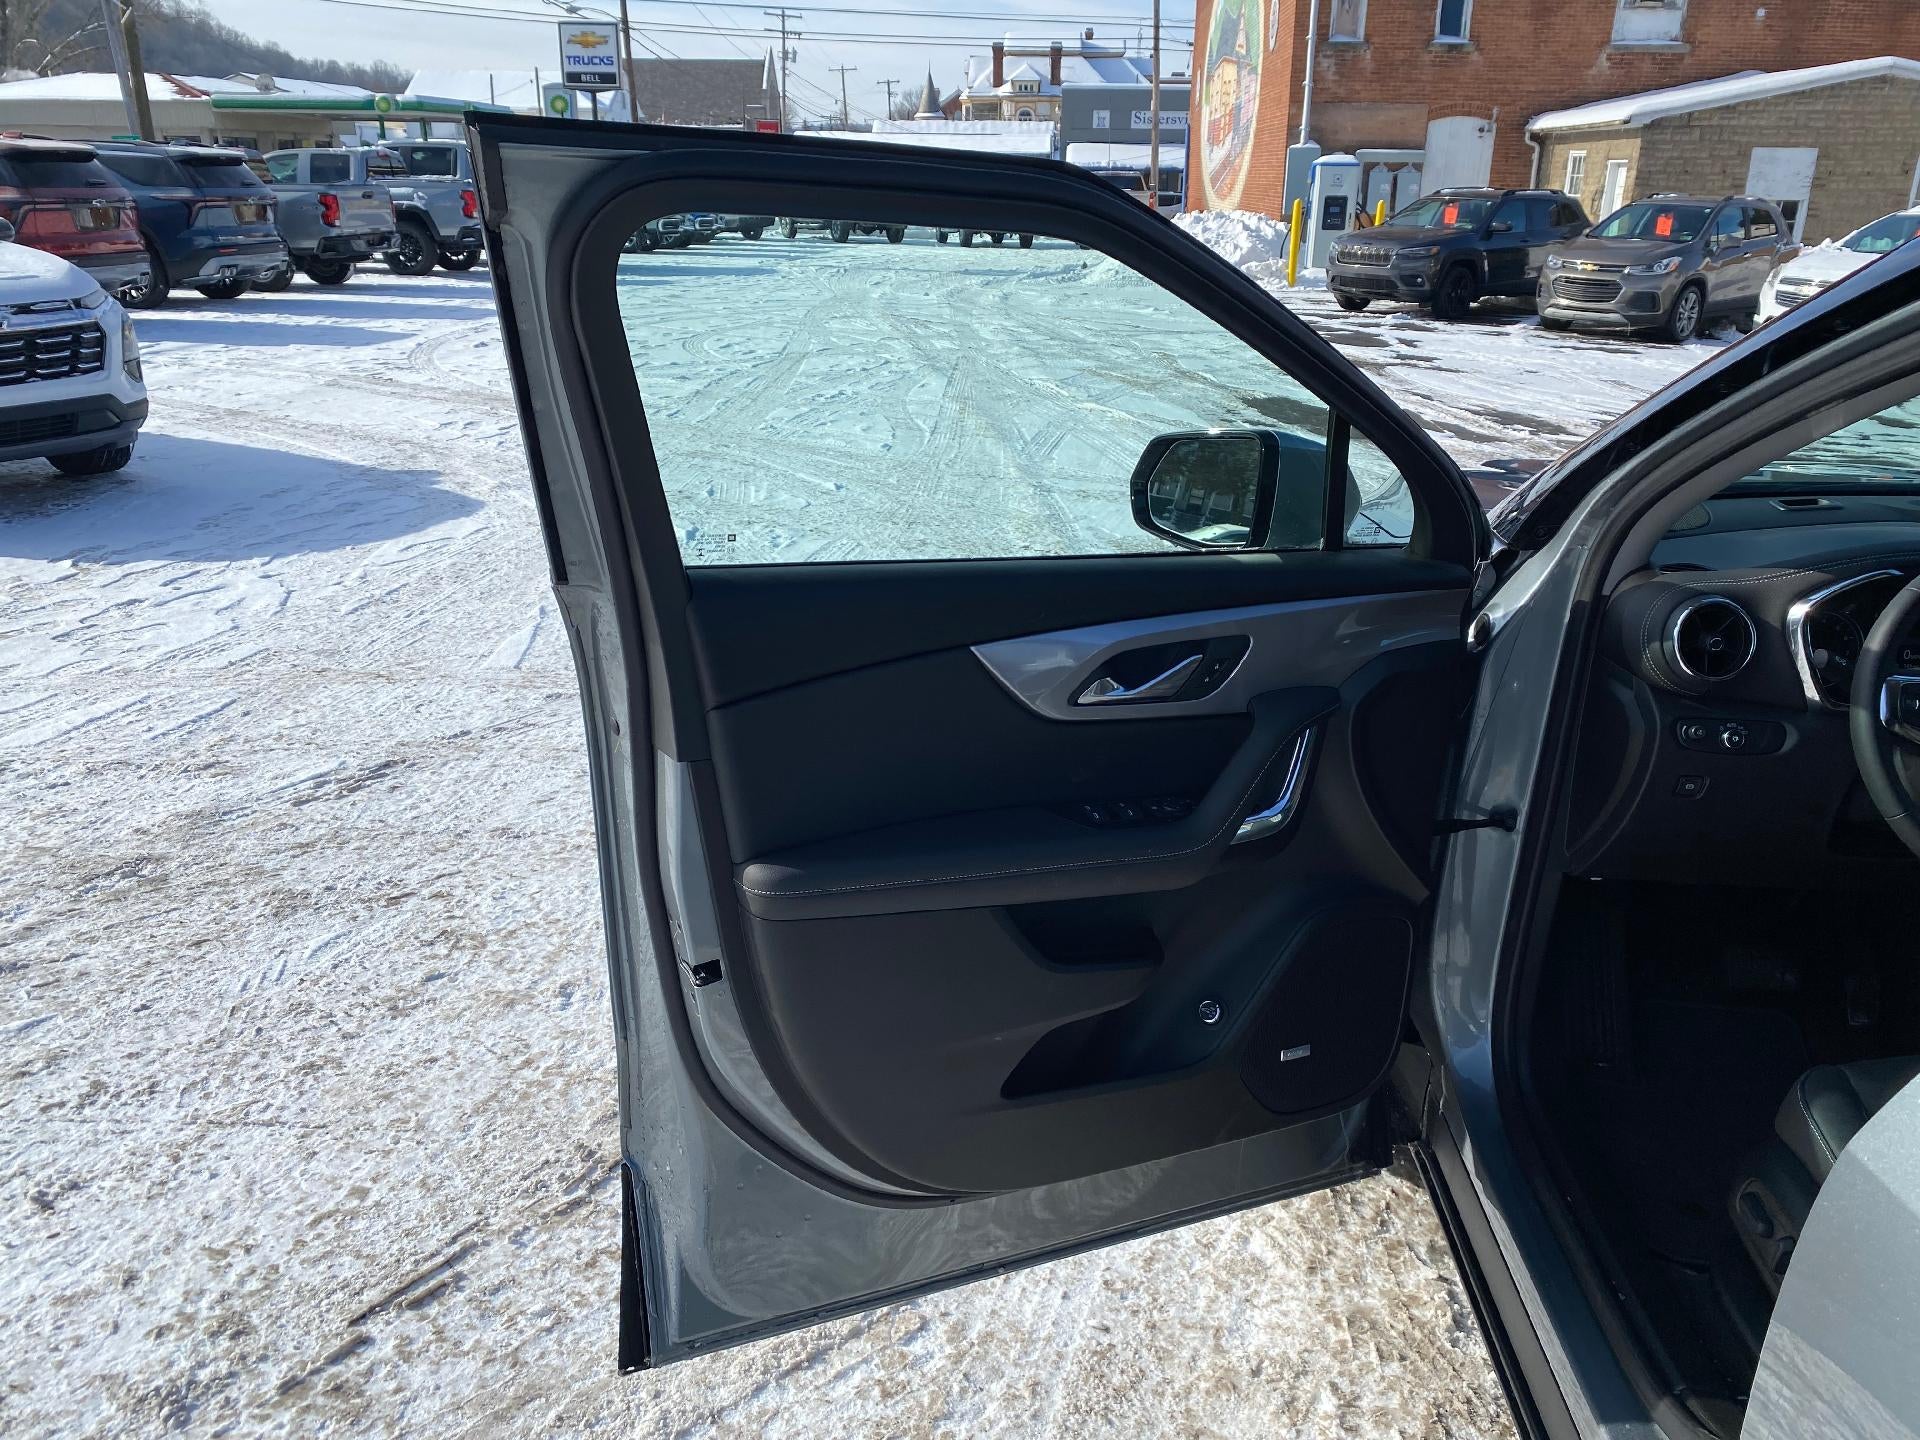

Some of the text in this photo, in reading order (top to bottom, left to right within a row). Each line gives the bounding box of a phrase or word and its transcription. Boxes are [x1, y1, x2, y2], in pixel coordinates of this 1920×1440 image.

[565, 55, 614, 66] TRUCKS
[580, 74, 601, 82] BELL
[1133, 111, 1189, 125] Sisersvi
